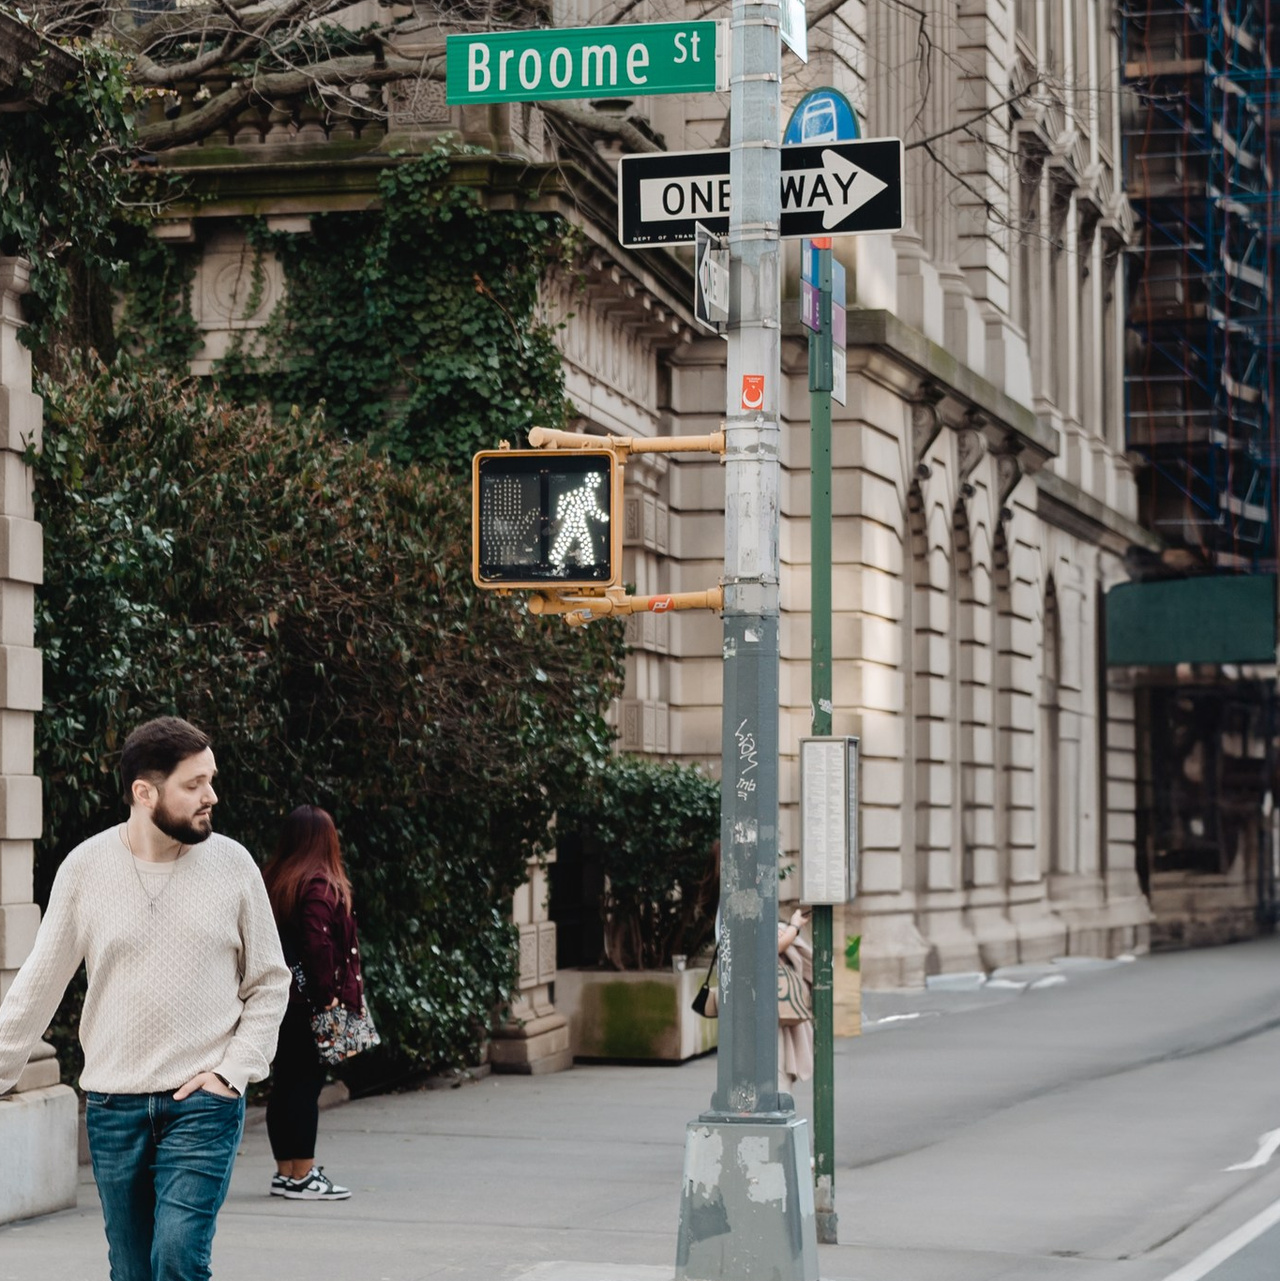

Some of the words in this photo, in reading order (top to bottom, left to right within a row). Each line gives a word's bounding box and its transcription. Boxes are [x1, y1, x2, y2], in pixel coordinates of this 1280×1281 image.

[468, 42, 650, 92] Broome
[673, 31, 701, 64] St
[663, 180, 730, 216] ONE
[780, 172, 858, 209] WAY
